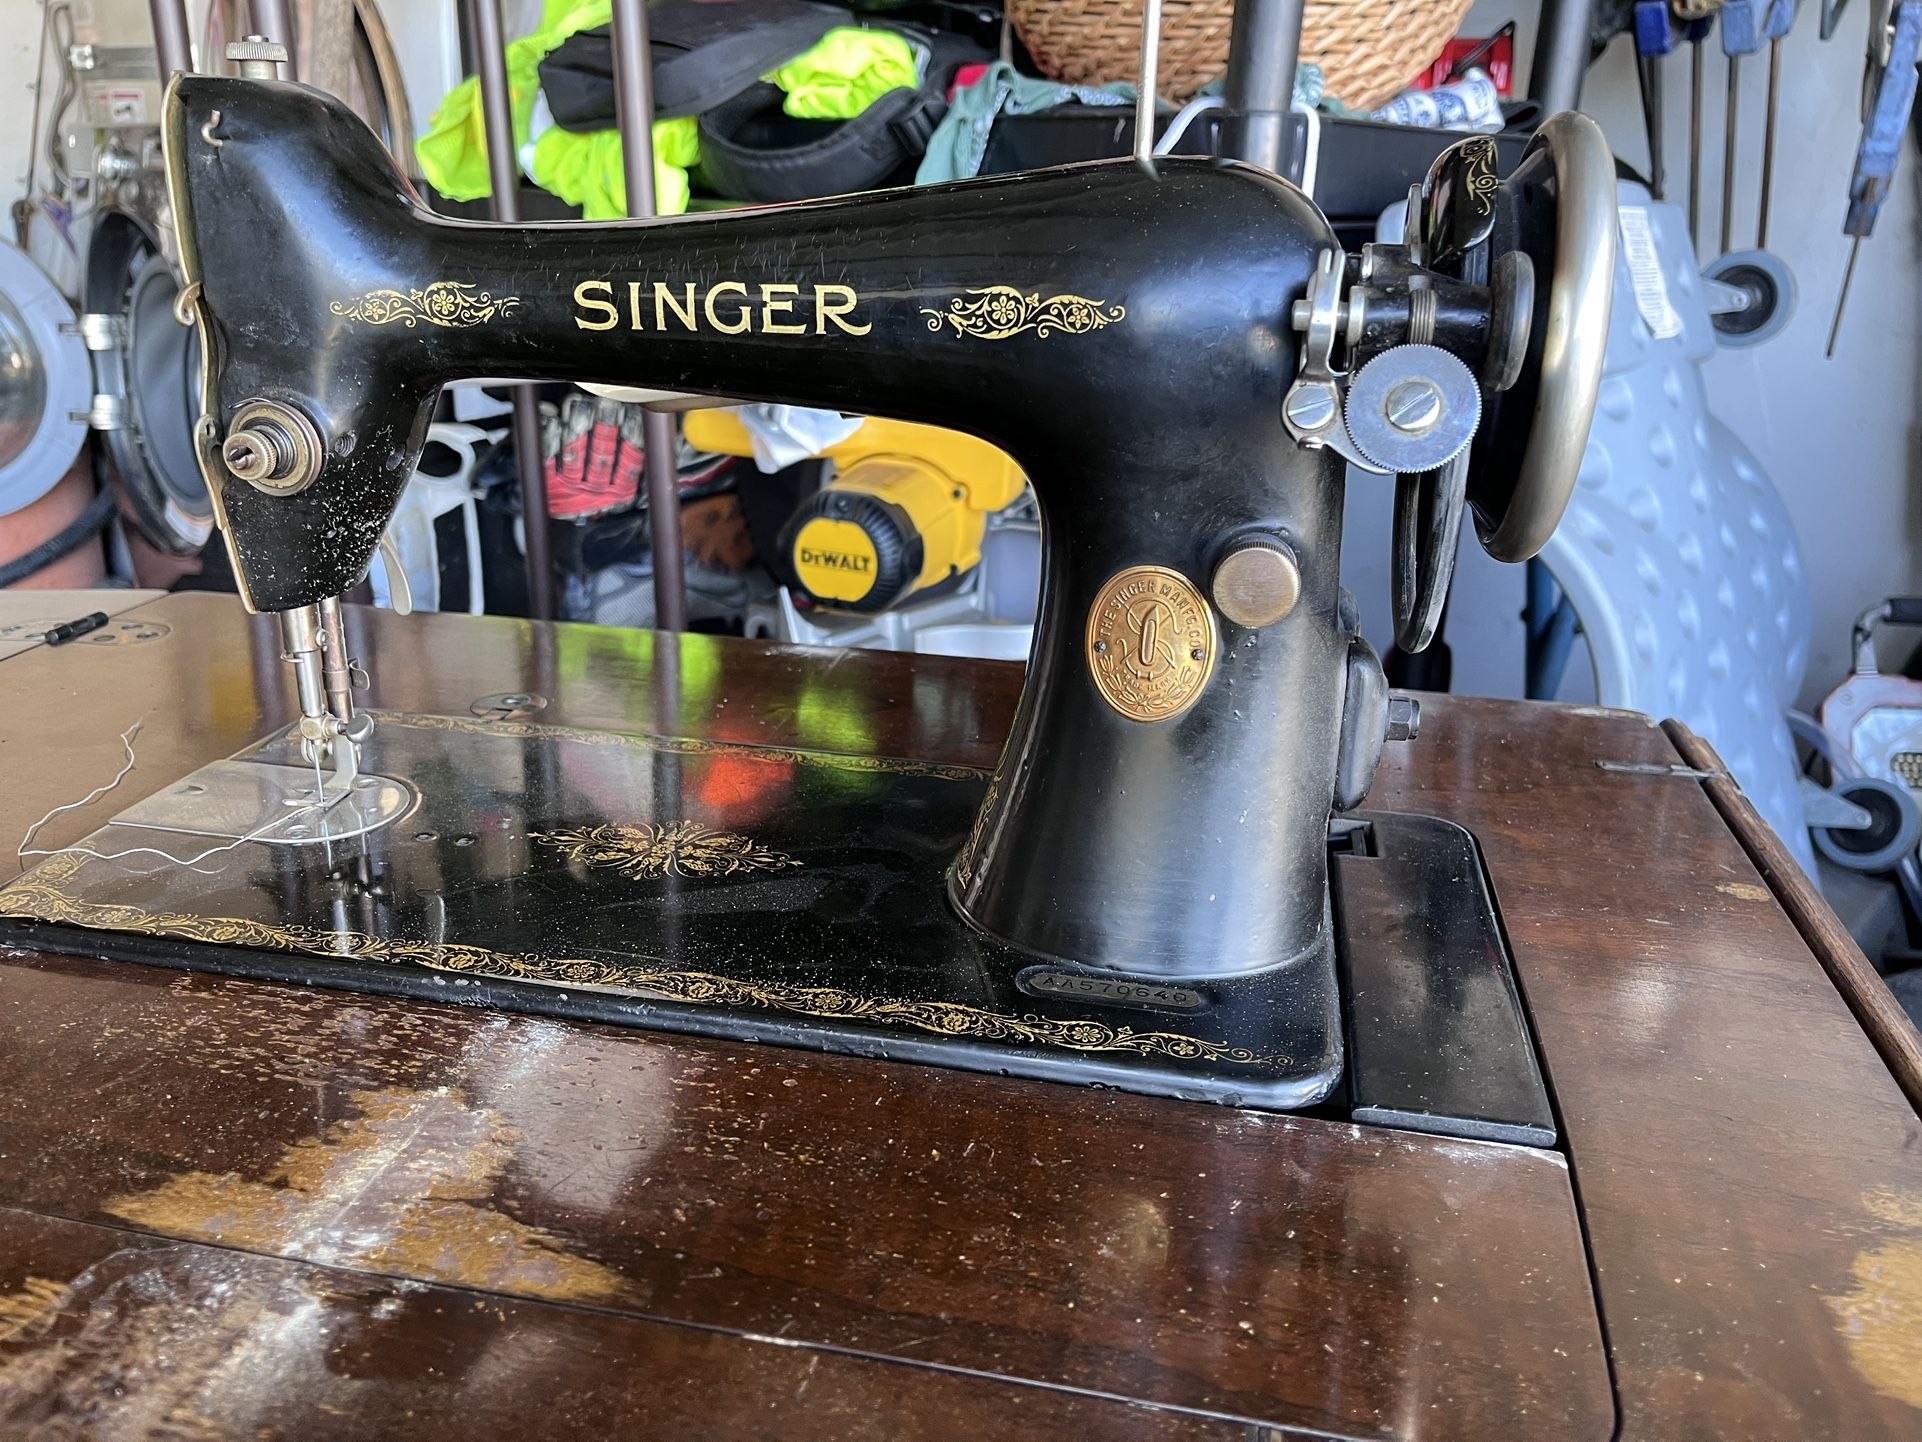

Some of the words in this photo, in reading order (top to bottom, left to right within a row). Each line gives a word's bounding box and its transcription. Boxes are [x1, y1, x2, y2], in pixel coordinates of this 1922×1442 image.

[573, 280, 872, 336] SINGER
[1100, 610, 1117, 637] THE
[1110, 580, 1157, 610] SINGER
